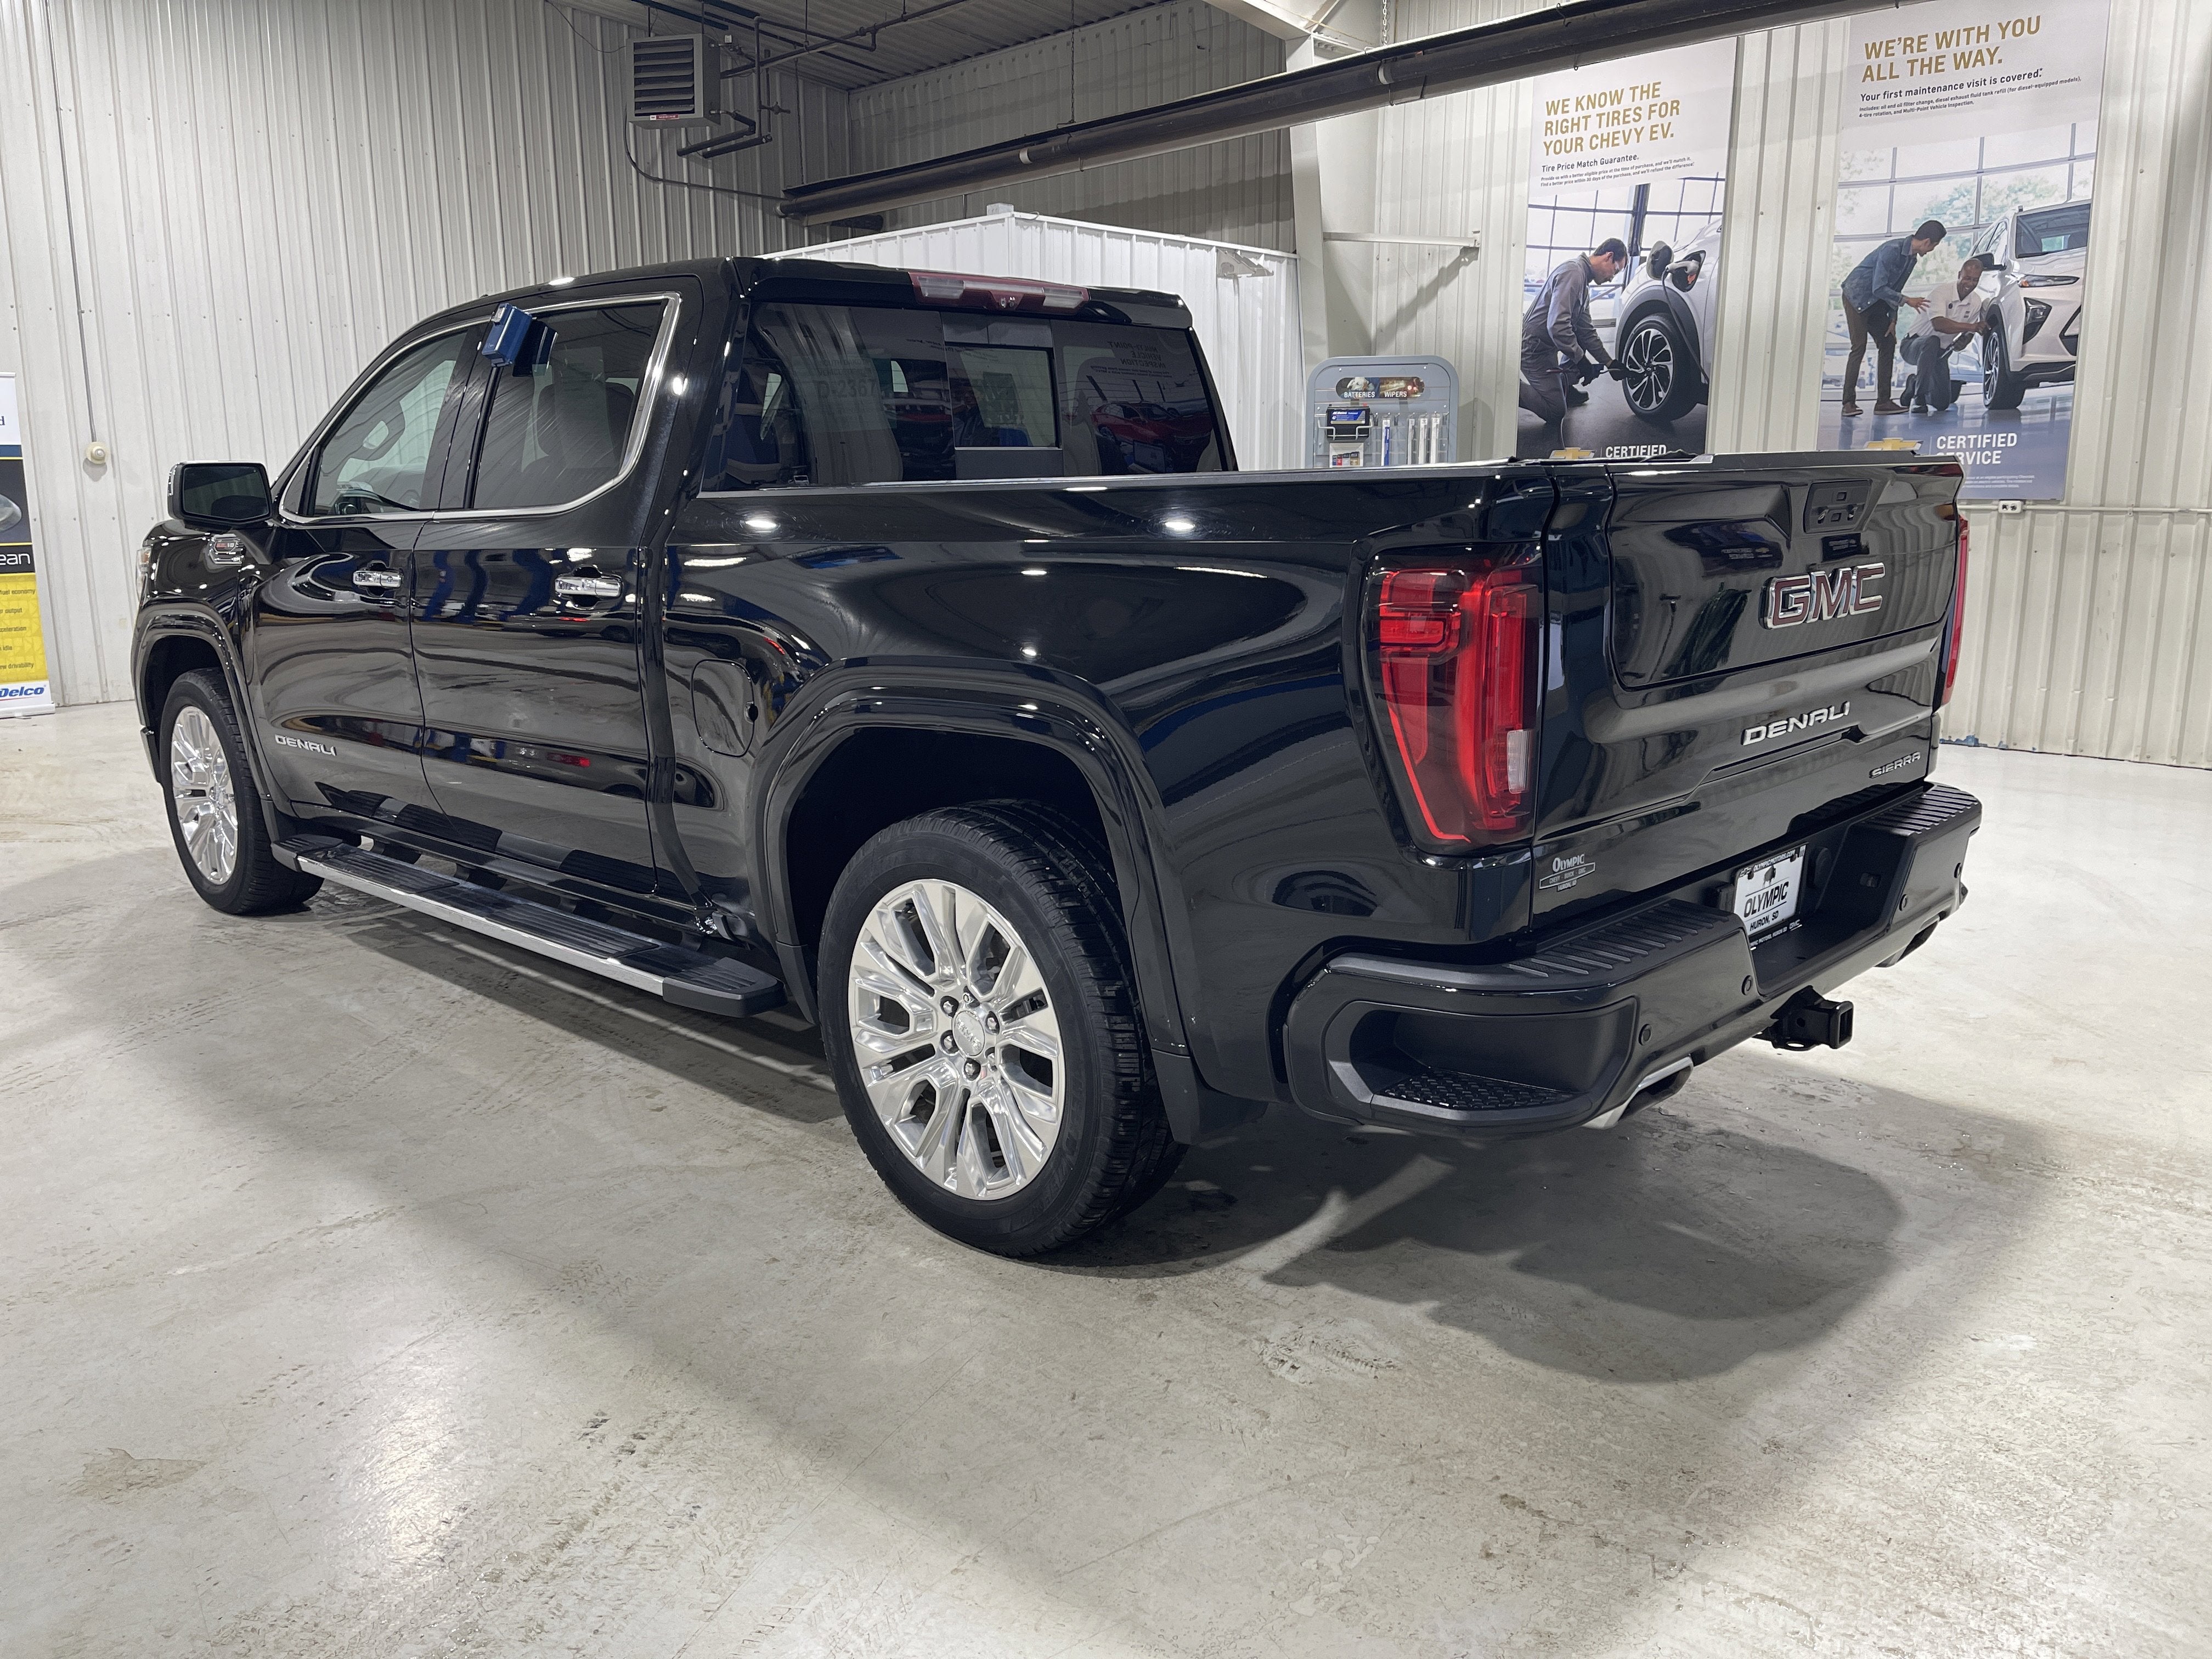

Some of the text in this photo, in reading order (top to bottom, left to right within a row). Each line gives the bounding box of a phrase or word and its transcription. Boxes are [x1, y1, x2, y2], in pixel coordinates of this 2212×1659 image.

[1865, 15, 2040, 60] WE'RE WITH YOU
[1861, 46, 2002, 83] ALL THE WAY.
[1546, 82, 1661, 116] WE KNOW THE
[1860, 93, 1881, 101] Your
[1883, 90, 1903, 99] first
[1905, 83, 1964, 97] maintenance
[1967, 78, 1987, 88] visit
[1989, 76, 1997, 85] is
[1544, 100, 1680, 136] RIGHT TIRES FOR
[1543, 122, 1674, 156] YOUR CHEVY EV.
[1557, 162, 1575, 171] Price
[1577, 159, 1598, 168] Match
[1600, 154, 1639, 165] Guarantee.
[1606, 444, 1667, 458] CERTIFIED
[1937, 433, 2017, 449] CERTIFIED
[1937, 450, 2002, 465] RVICE
[1761, 562, 1886, 629] GMC
[1741, 701, 1850, 746] DENALI
[275, 734, 337, 757] DENALI
[1870, 751, 1921, 778] SIERRA
[1552, 853, 1584, 872] OLYMPIC
[1743, 881, 1789, 918] OLYMPIC
[1750, 910, 1779, 932] HURON, SD
